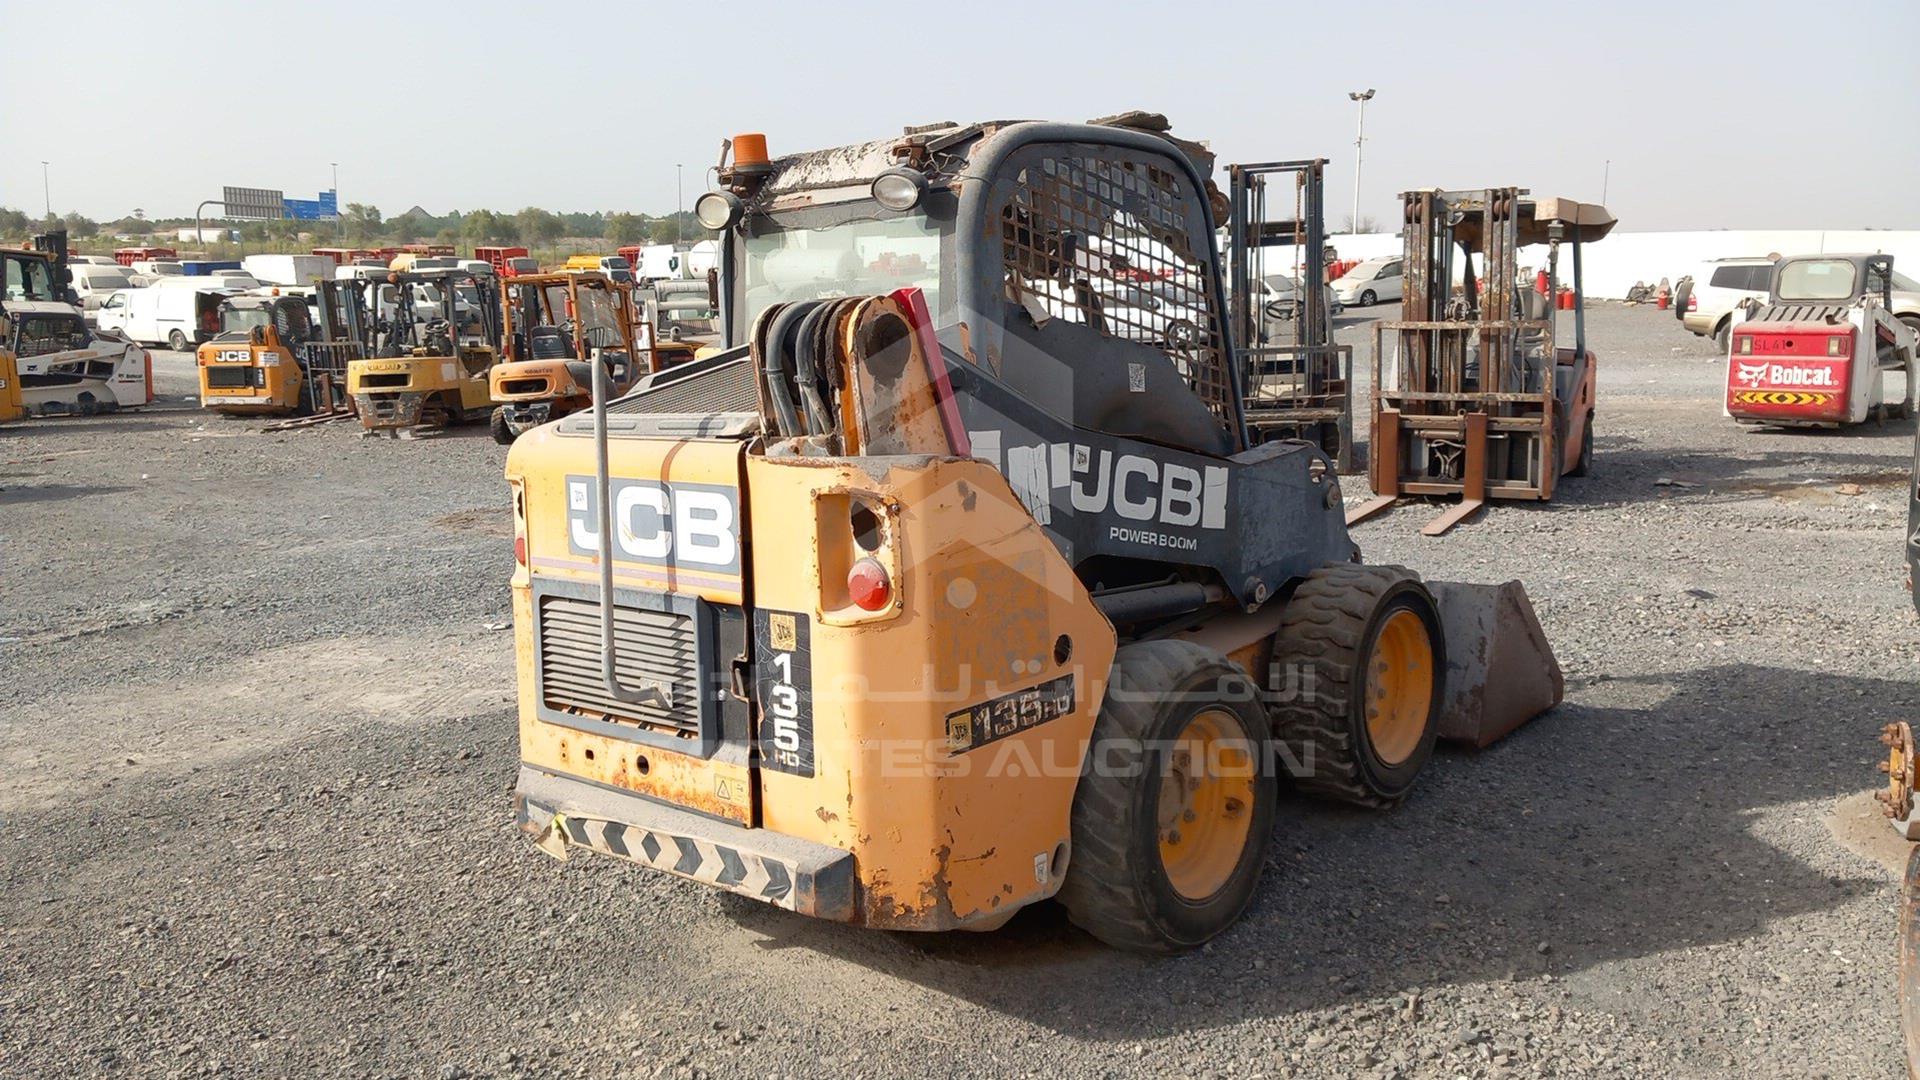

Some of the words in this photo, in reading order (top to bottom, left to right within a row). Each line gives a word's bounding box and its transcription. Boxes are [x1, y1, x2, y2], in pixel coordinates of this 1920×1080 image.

[215, 351, 251, 362] JCB
[1770, 365, 1833, 386] Bobcat
[569, 478, 737, 566] JCB
[1070, 444, 1203, 527] JCB
[773, 653, 800, 752] 135
